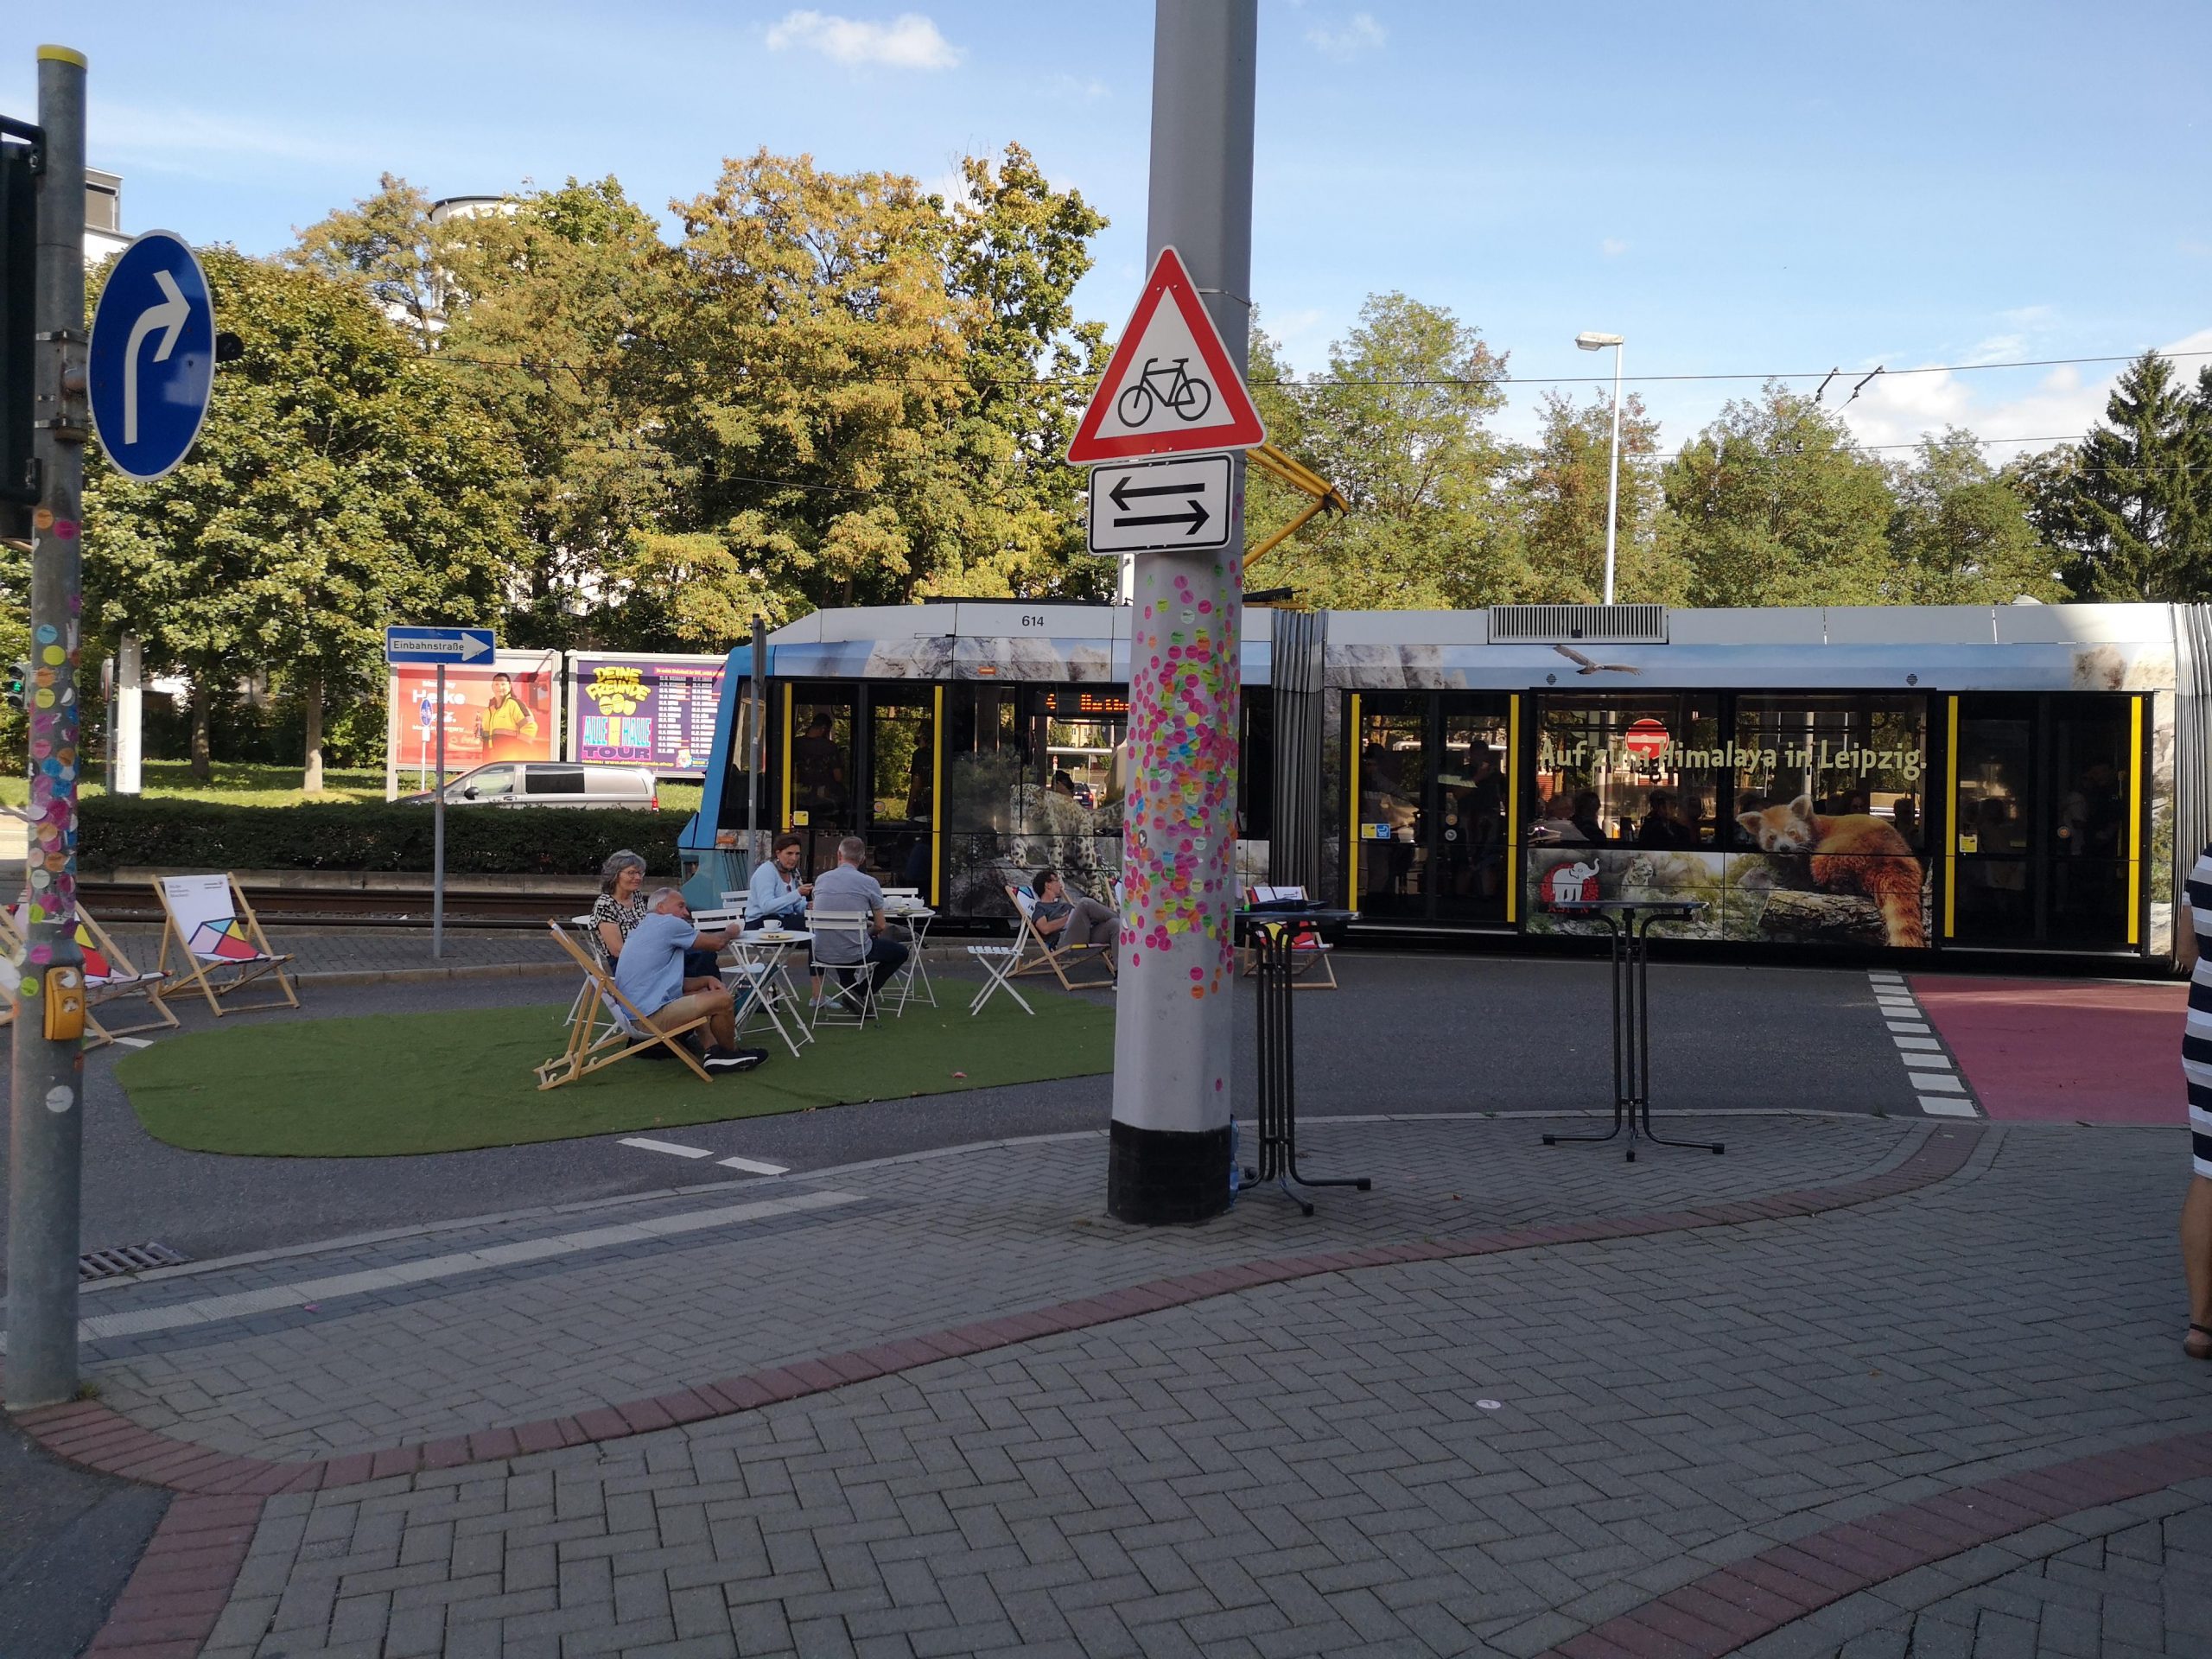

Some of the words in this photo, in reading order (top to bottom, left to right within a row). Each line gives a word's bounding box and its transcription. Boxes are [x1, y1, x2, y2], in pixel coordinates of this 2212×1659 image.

[1022, 615, 1044, 626] 614
[393, 640, 465, 652] Einbahnstraße
[593, 666, 643, 683] DEINE
[412, 689, 466, 705] Heke
[585, 680, 652, 701] FREUNDE
[583, 715, 608, 746] ALLE
[621, 716, 652, 747] HALLE
[583, 746, 651, 760] TOUR
[1540, 738, 1588, 767] Auf
[1592, 748, 1650, 767] zum
[1658, 740, 1777, 774] Himalaya
[1784, 741, 1813, 768] in
[1820, 739, 1928, 781] Leipzig.
